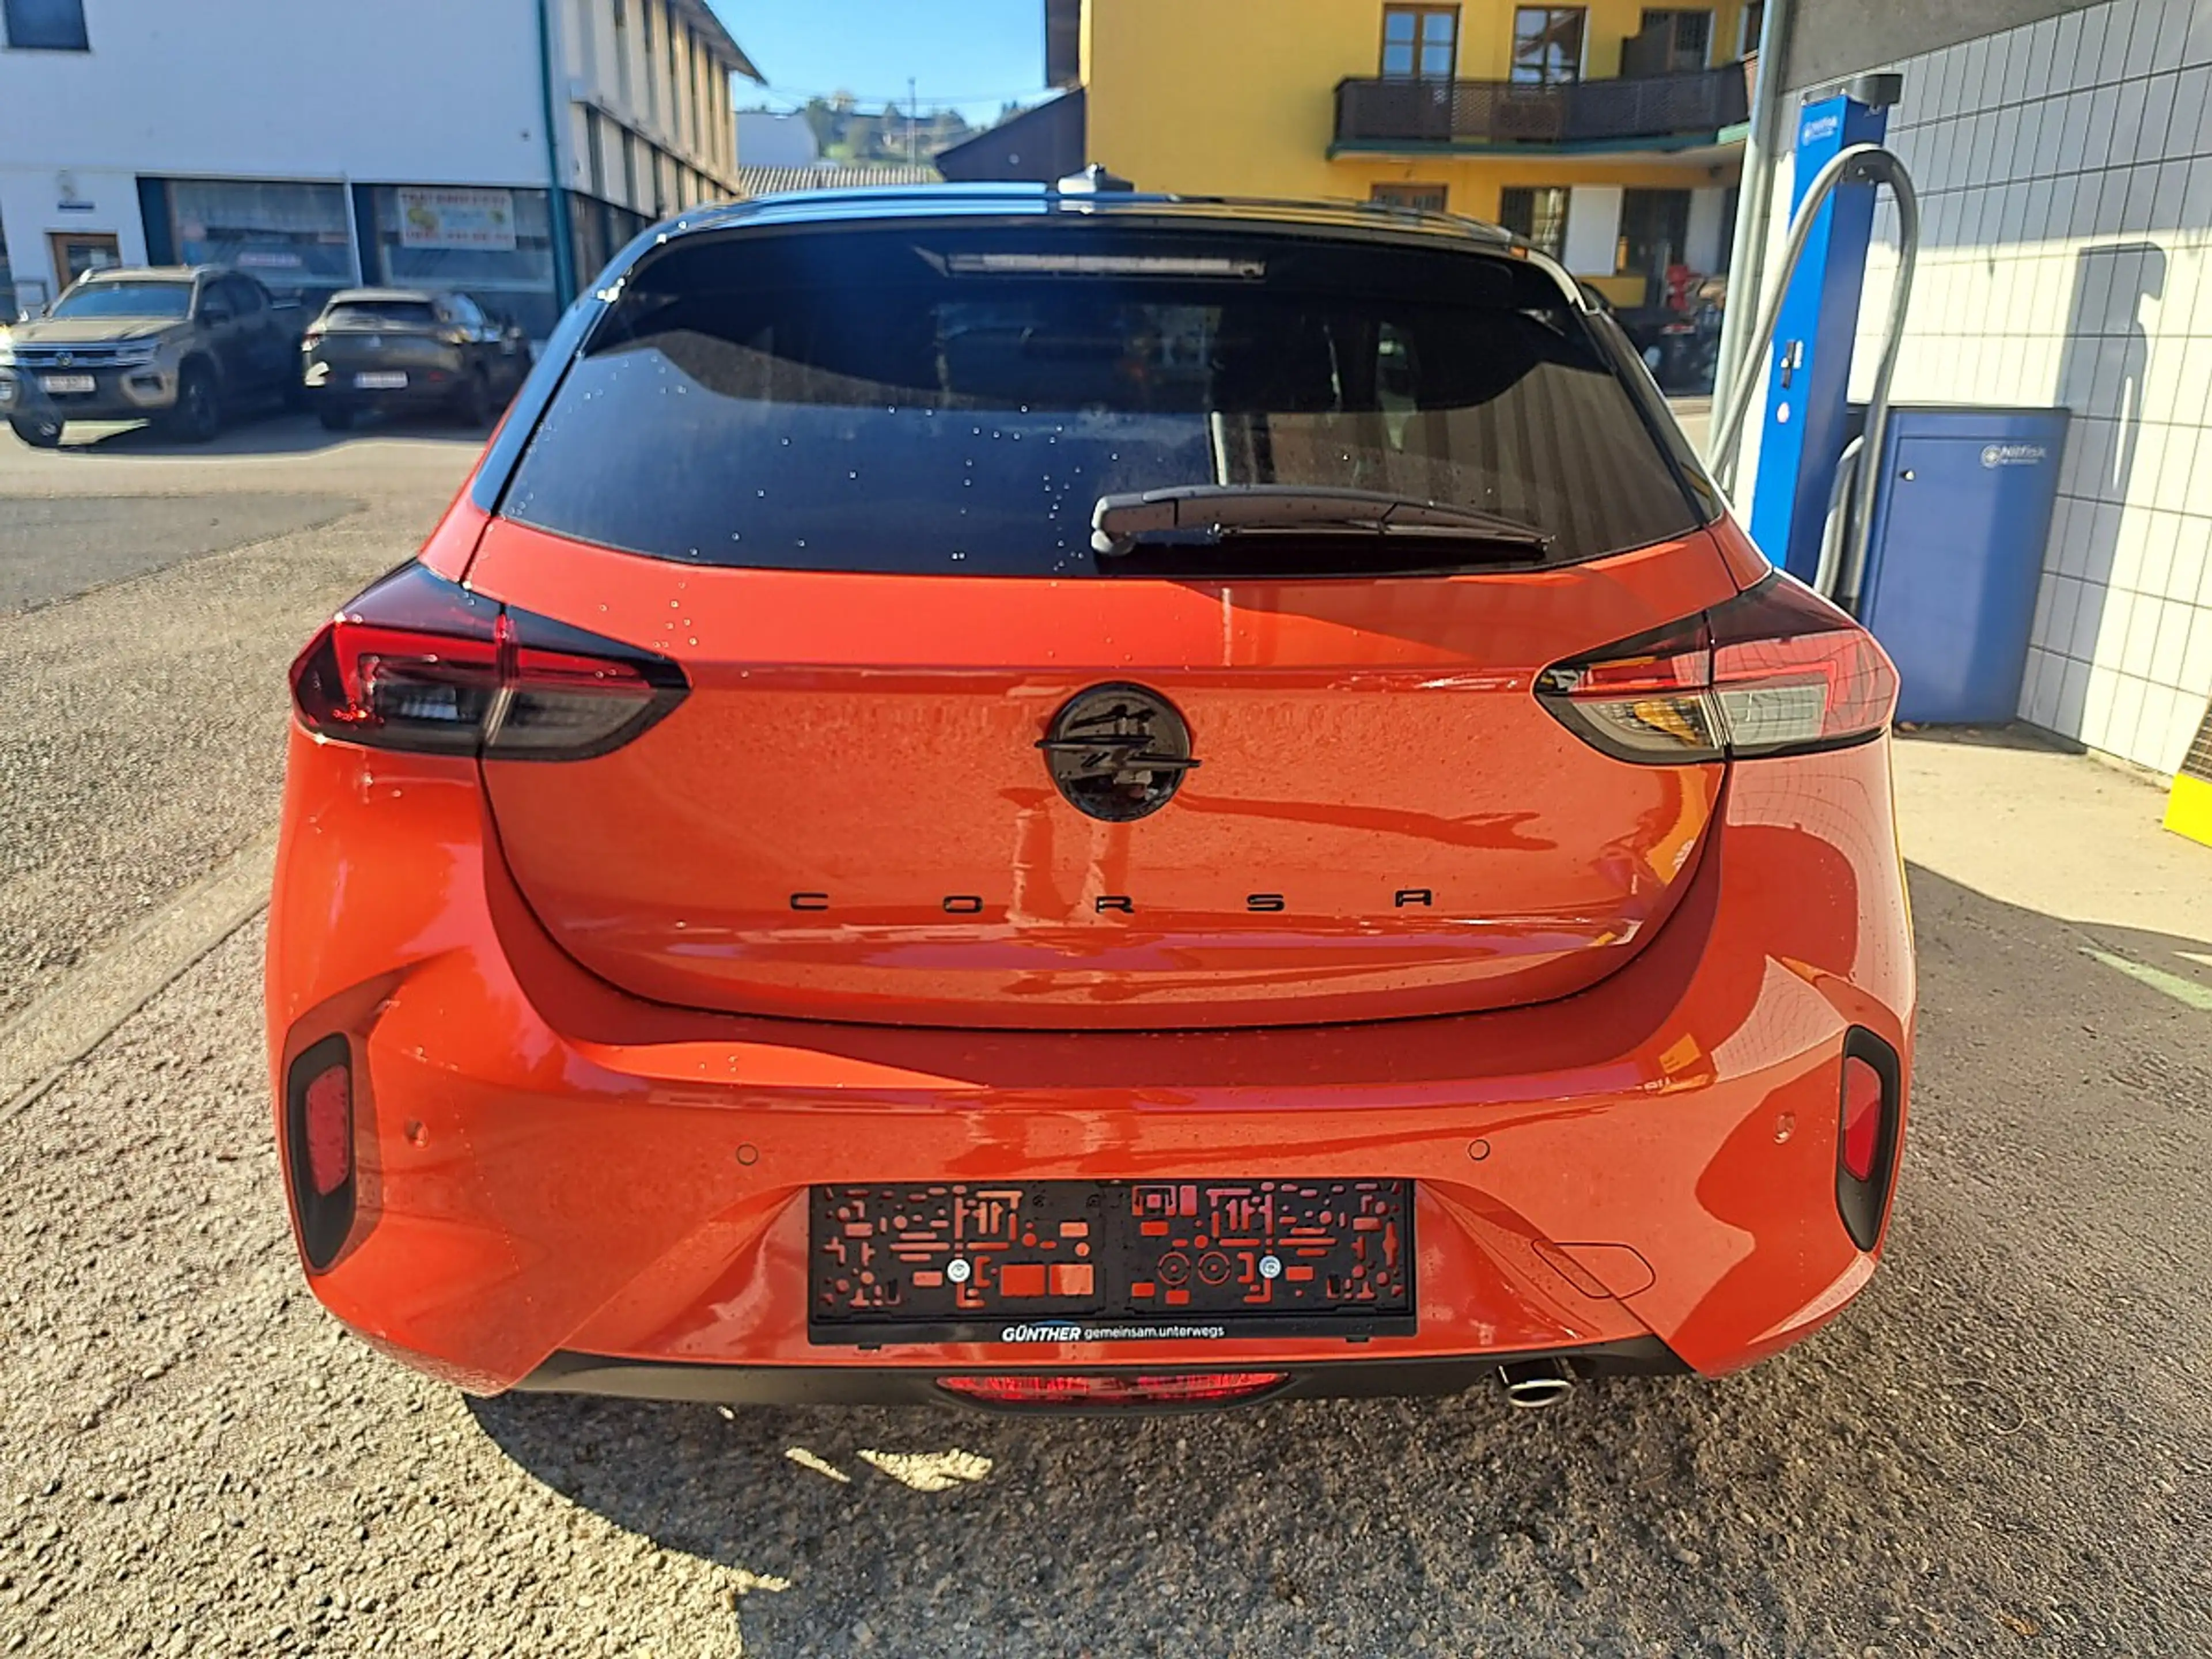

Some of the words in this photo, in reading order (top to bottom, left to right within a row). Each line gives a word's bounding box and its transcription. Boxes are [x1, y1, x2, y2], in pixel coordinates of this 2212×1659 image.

[790, 889, 1431, 914] CORSA
[1002, 1325, 1081, 1342] GÜNTHER
[1084, 1325, 1225, 1340] gemeinsam.unterwegs
